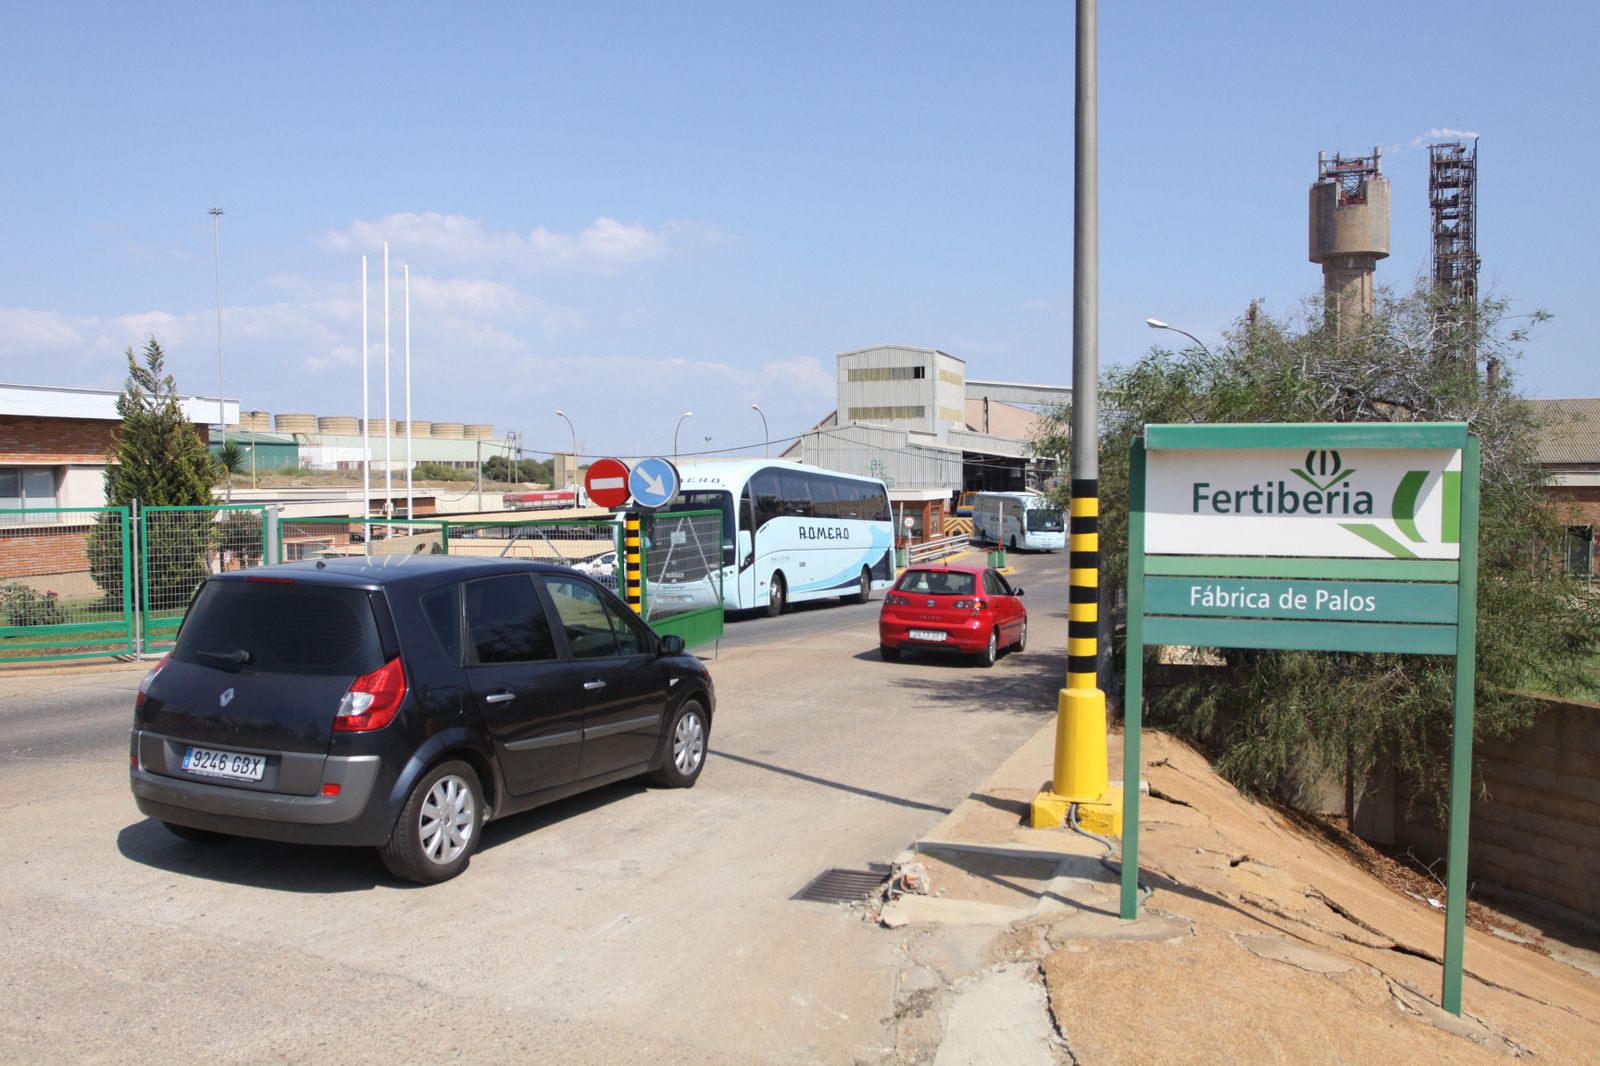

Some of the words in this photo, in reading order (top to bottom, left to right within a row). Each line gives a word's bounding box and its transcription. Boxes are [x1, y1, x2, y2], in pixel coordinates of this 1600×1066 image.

[1192, 481, 1373, 515] Fertiberia
[798, 526, 850, 540] ROMERO
[1190, 585, 1270, 609] Fábrica
[1278, 588, 1307, 610] de
[1316, 589, 1376, 612] Palos
[193, 751, 228, 771] 9246
[231, 756, 262, 776] GBX
